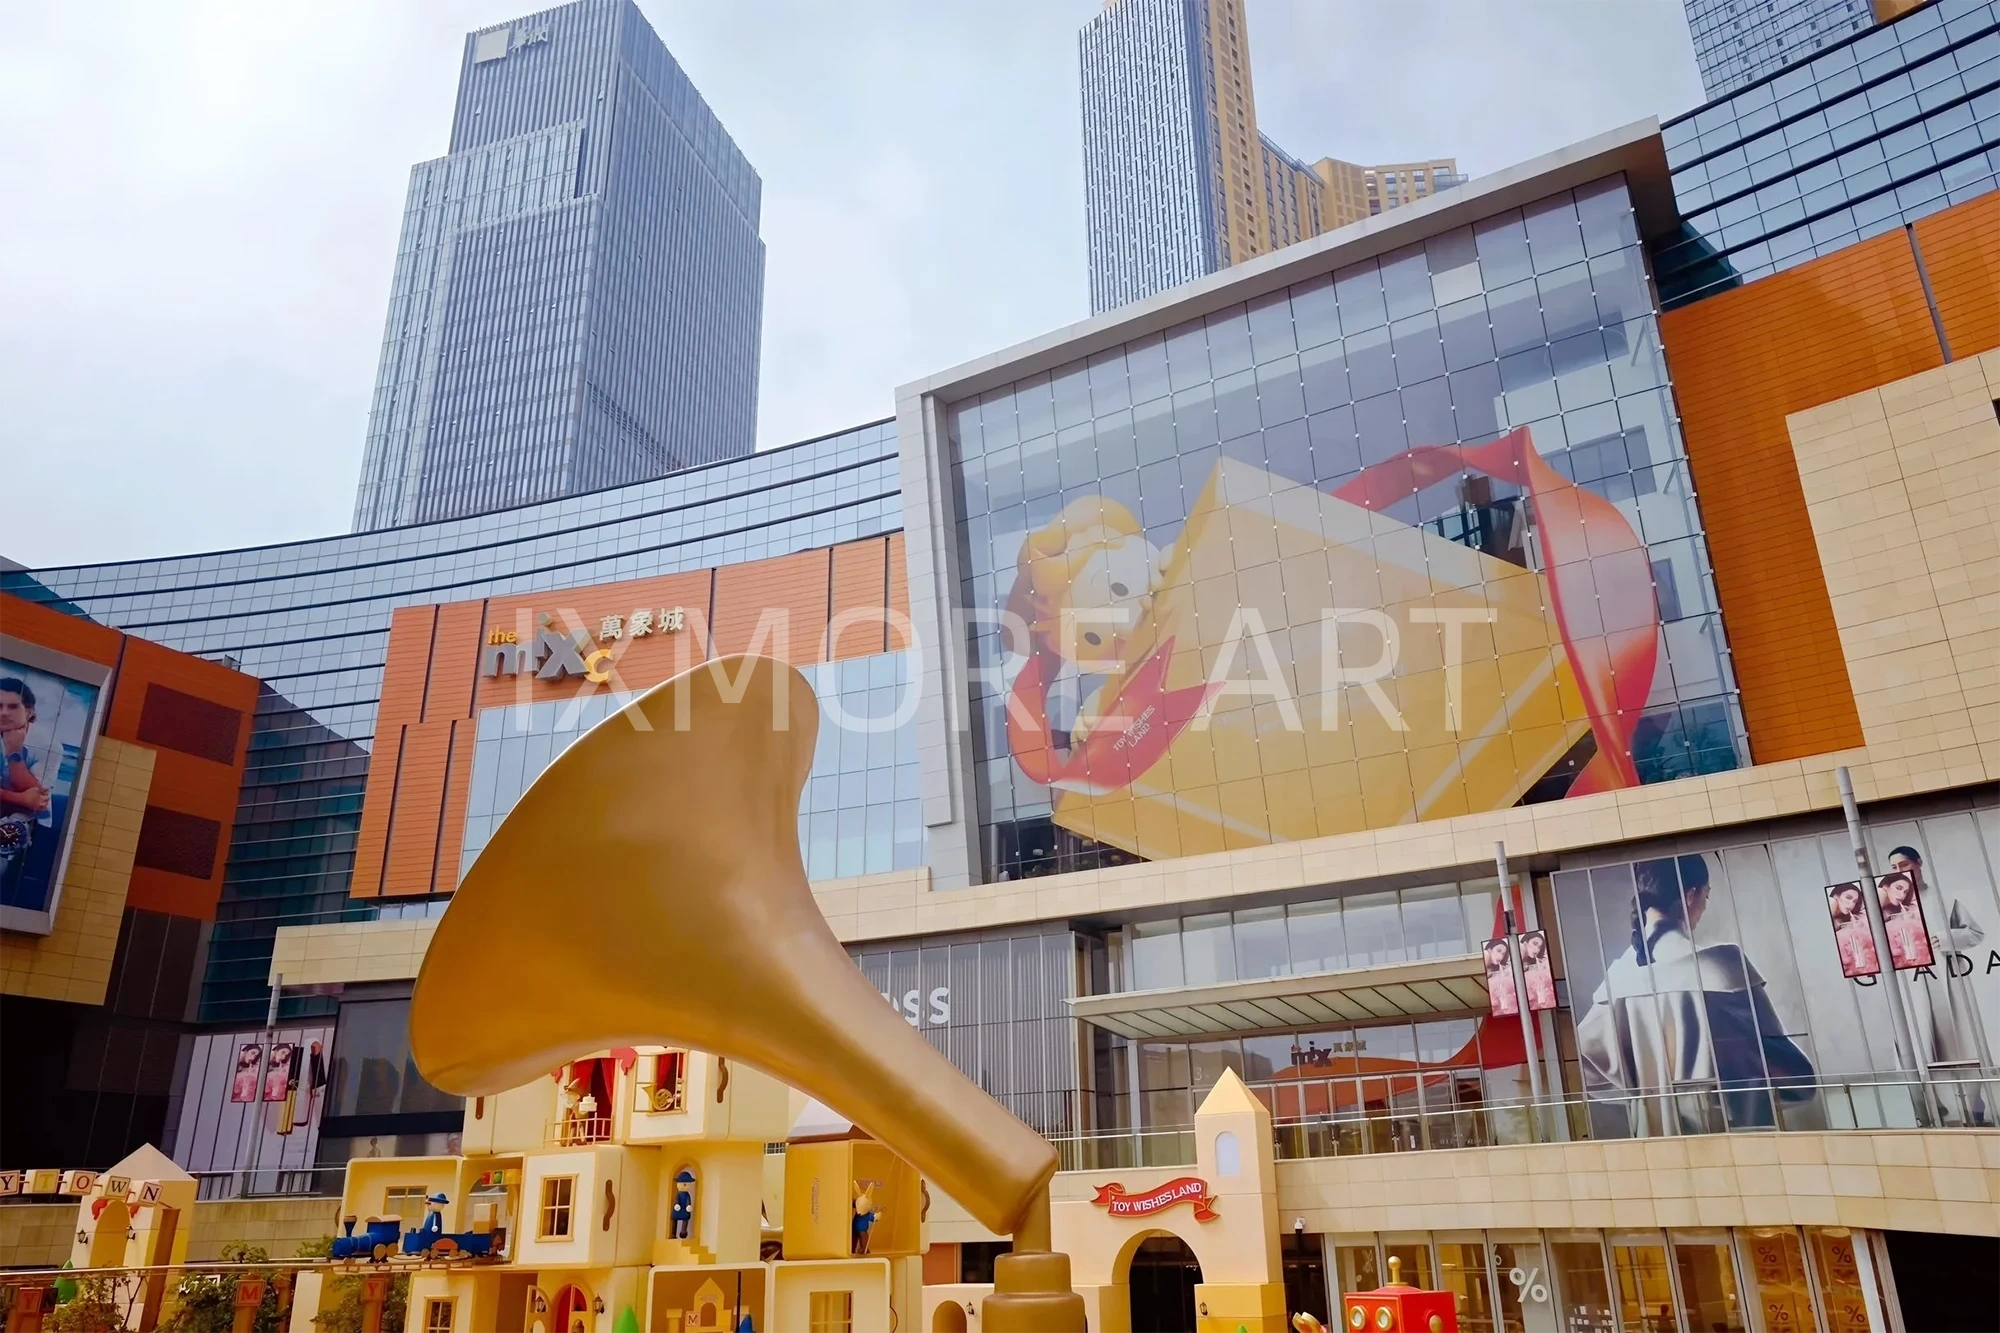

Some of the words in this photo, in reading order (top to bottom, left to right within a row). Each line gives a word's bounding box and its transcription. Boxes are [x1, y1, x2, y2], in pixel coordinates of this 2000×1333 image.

[486, 625, 518, 645] the
[599, 605, 685, 642] 萬象城
[1112, 735, 1127, 751] TOY
[1127, 722, 1150, 747] LAND
[1112, 1201, 1131, 1212] TOY
[1133, 1191, 1173, 1211] WISHES
[1172, 1182, 1202, 1199] LAND
